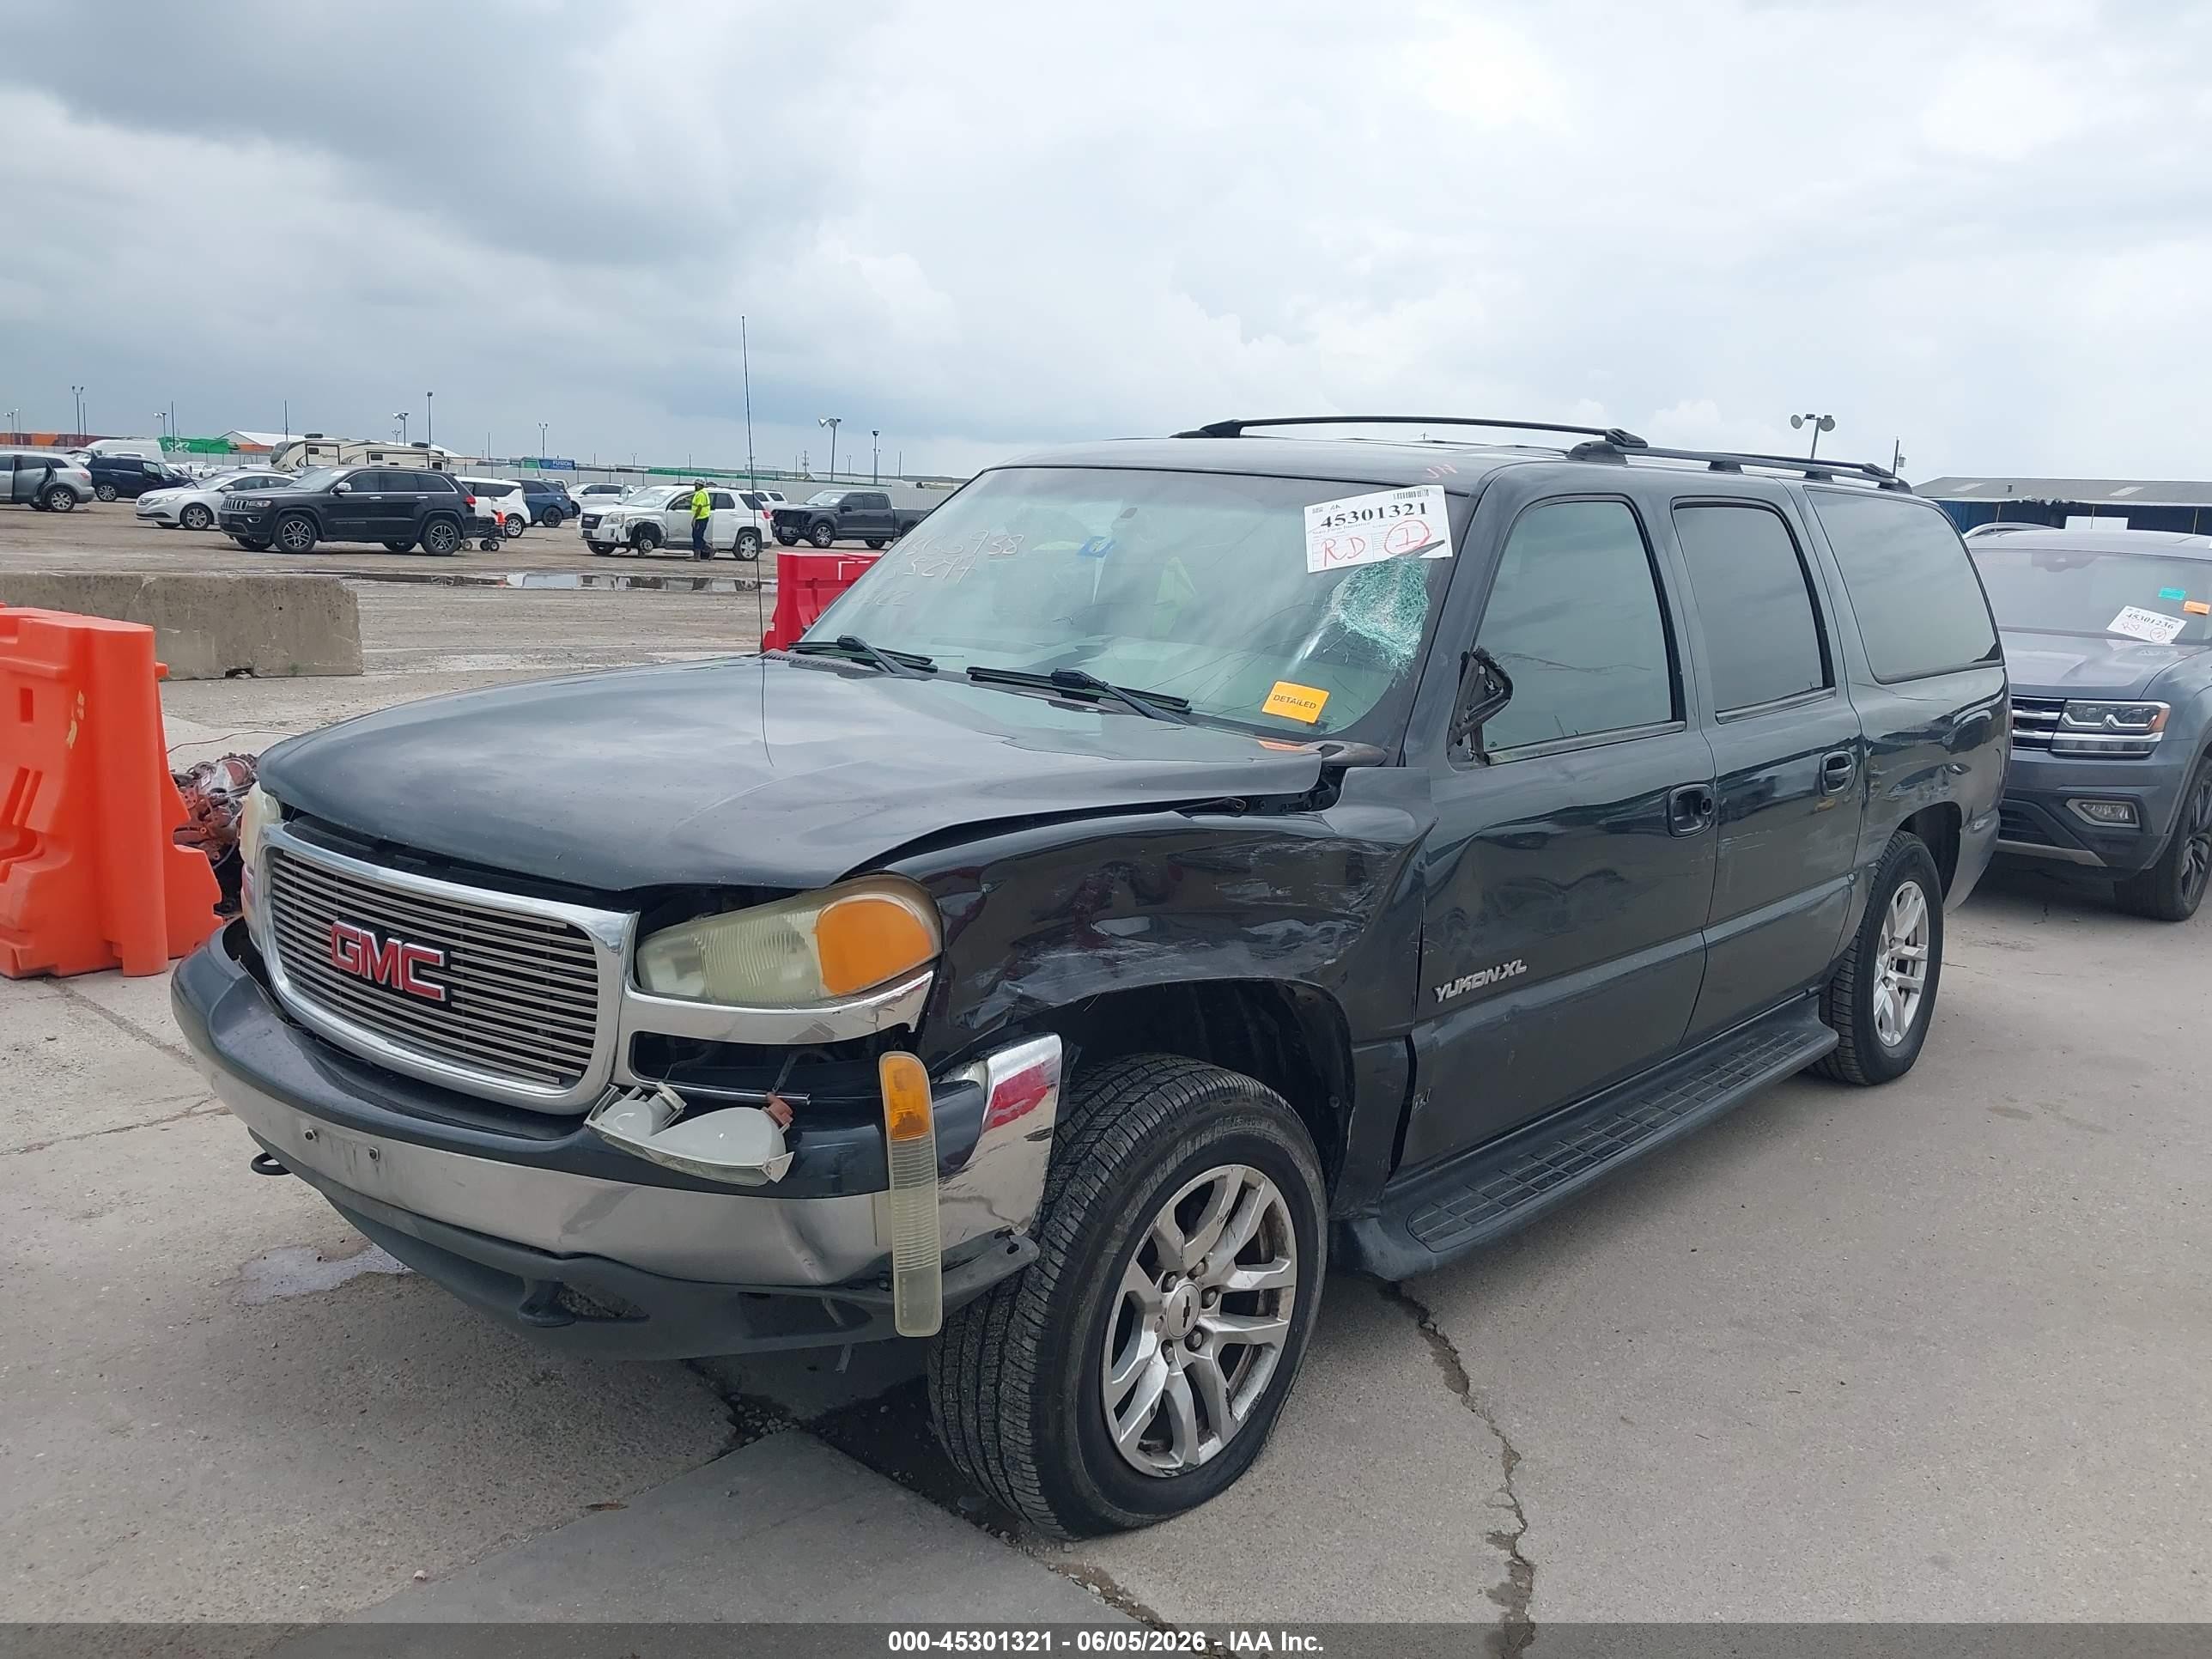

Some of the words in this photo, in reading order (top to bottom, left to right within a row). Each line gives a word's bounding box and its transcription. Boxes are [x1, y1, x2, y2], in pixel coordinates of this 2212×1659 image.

[1321, 502, 1427, 527] 45301321
[1273, 695, 1316, 709] DETAILED
[331, 920, 446, 1002] GMC
[1434, 967, 1500, 1003] YUKON
[1499, 959, 1528, 980] XL
